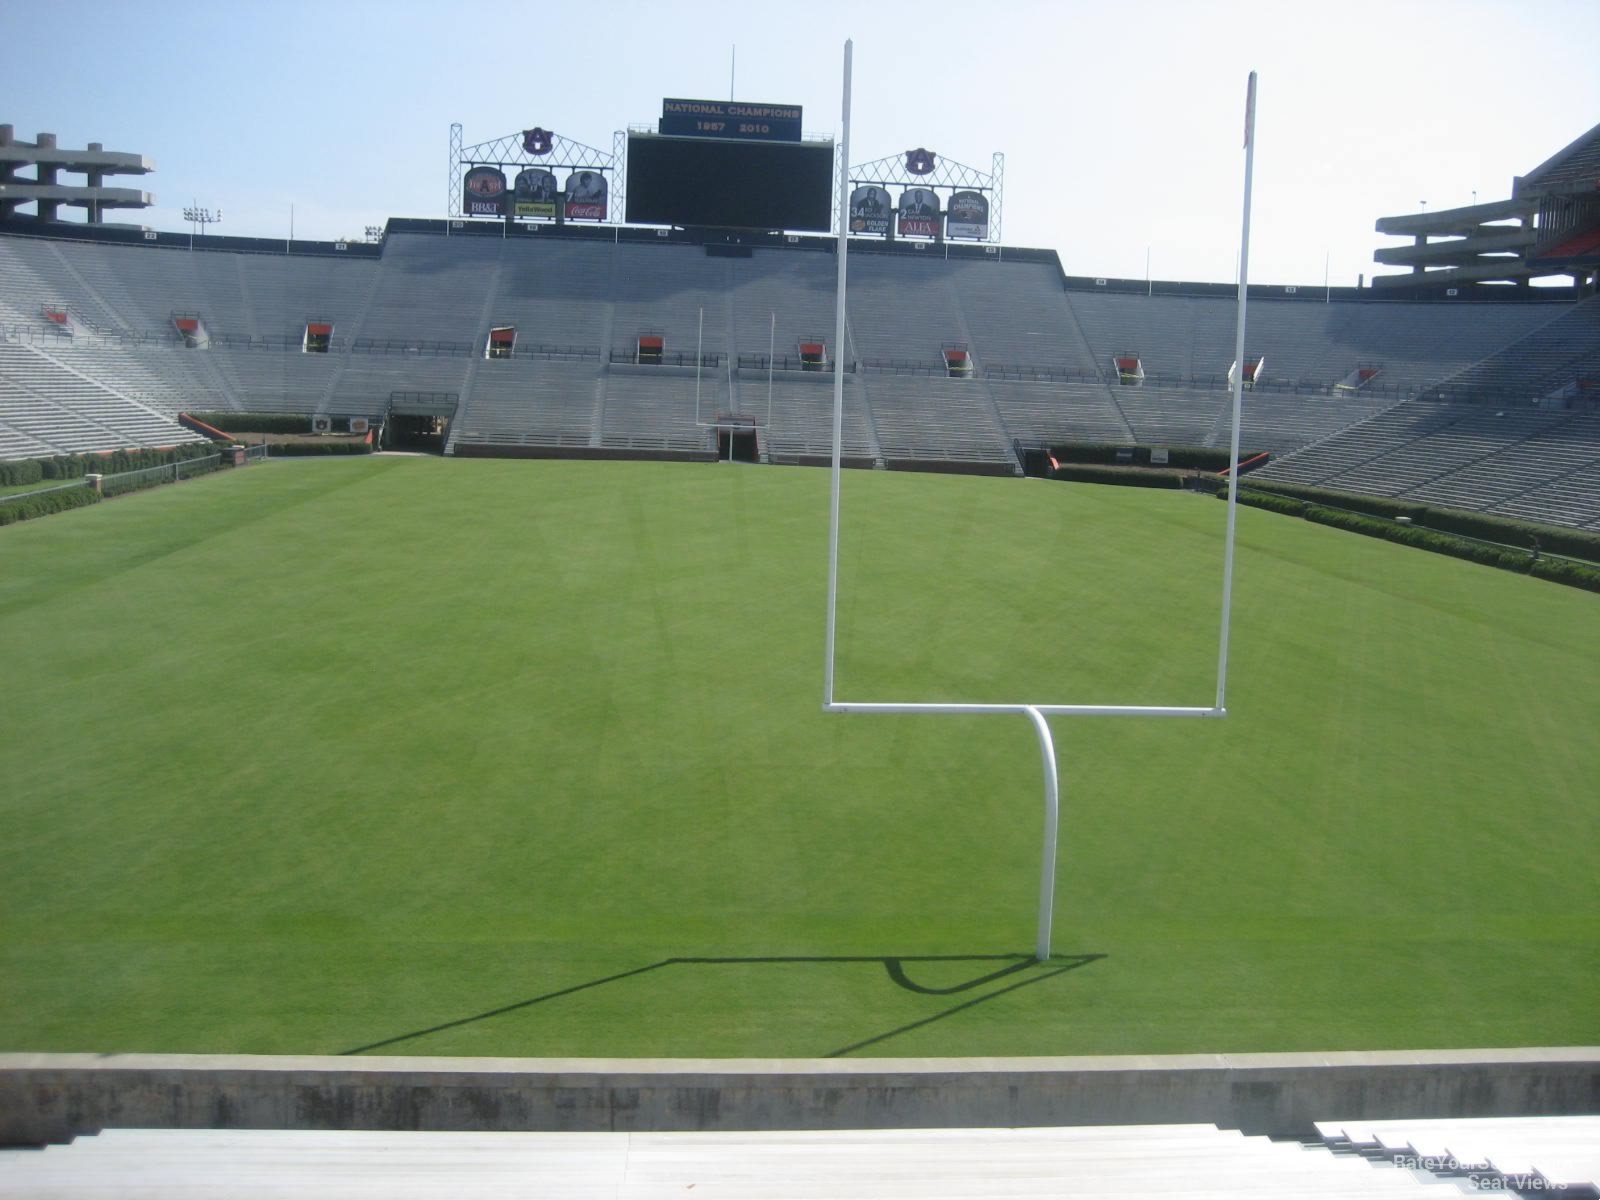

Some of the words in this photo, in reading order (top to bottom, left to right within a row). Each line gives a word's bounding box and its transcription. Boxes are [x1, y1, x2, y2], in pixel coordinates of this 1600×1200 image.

[665, 103, 724, 115] NATIONAL
[728, 106, 800, 118] CHAMPIONS
[697, 121, 726, 131] 1957
[739, 123, 769, 133] 2010
[471, 202, 497, 213] BB&T
[851, 207, 865, 218] 34
[901, 209, 908, 220] 2
[866, 219, 889, 227] GOLDEN
[904, 221, 932, 232] ALFA
